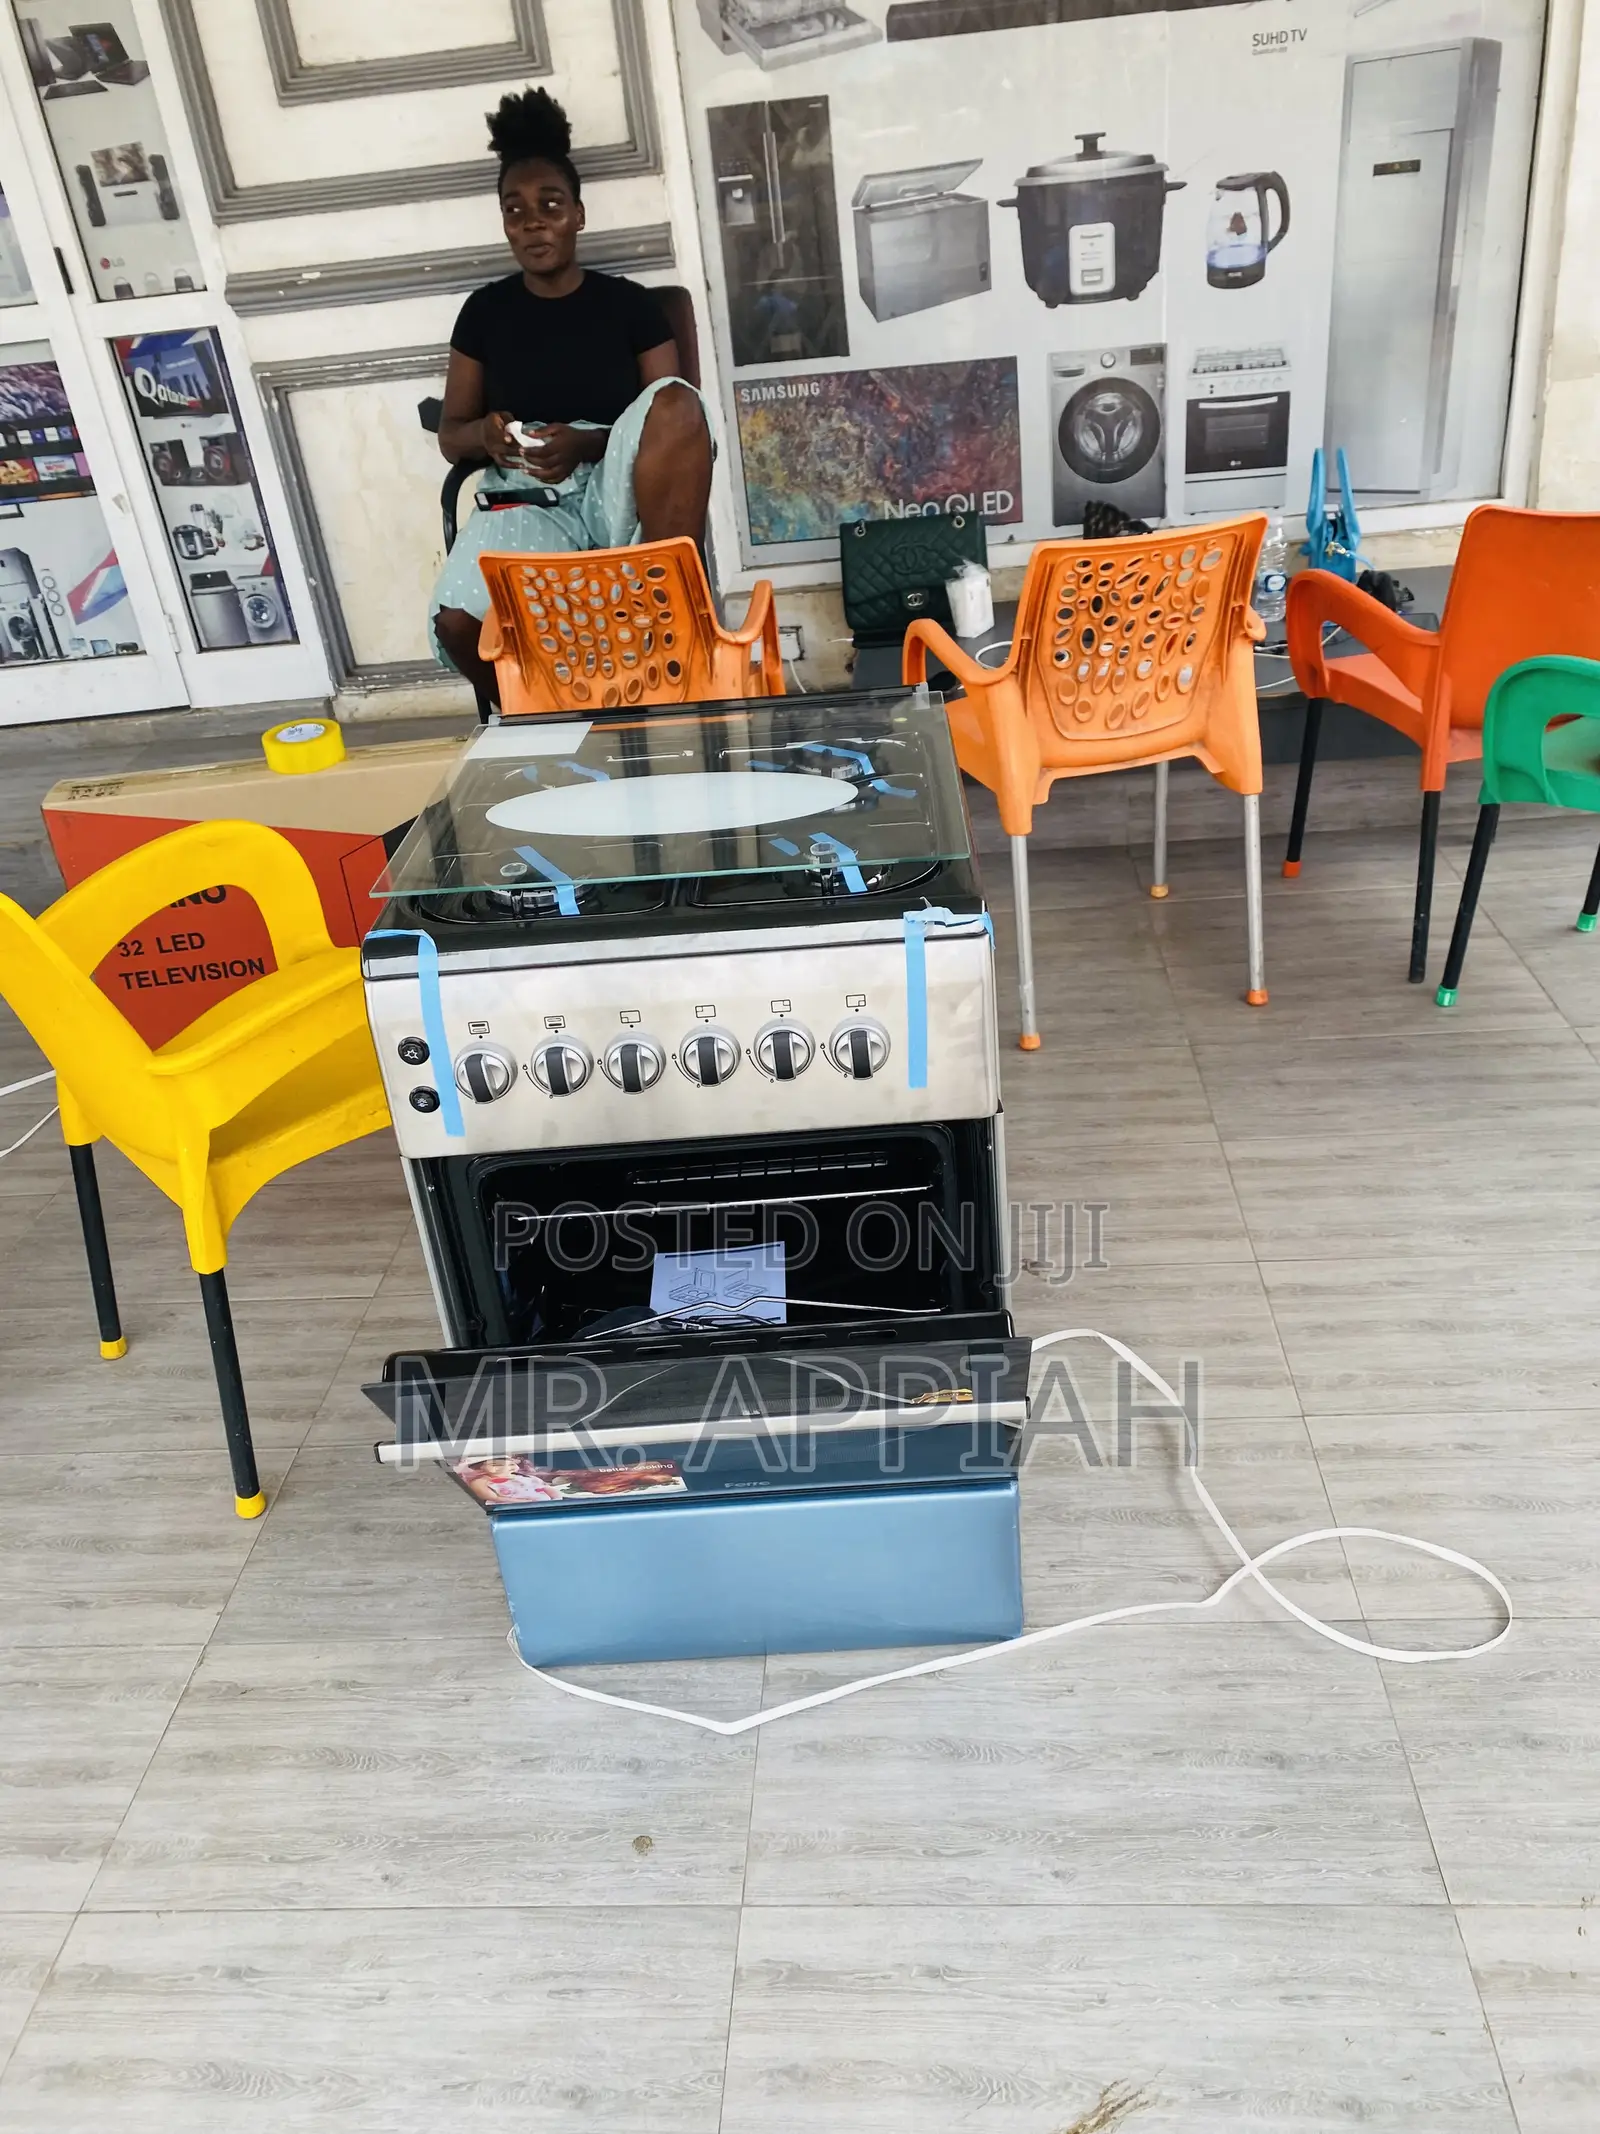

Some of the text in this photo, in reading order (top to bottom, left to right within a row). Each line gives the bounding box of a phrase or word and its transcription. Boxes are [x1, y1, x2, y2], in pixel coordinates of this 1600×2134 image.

[1252, 28, 1307, 47] SUHD TV
[740, 381, 820, 404] SAMSUNG
[117, 932, 205, 957] 32 LED
[118, 957, 265, 990] TELEVISION
[631, 1463, 675, 1471] cooking
